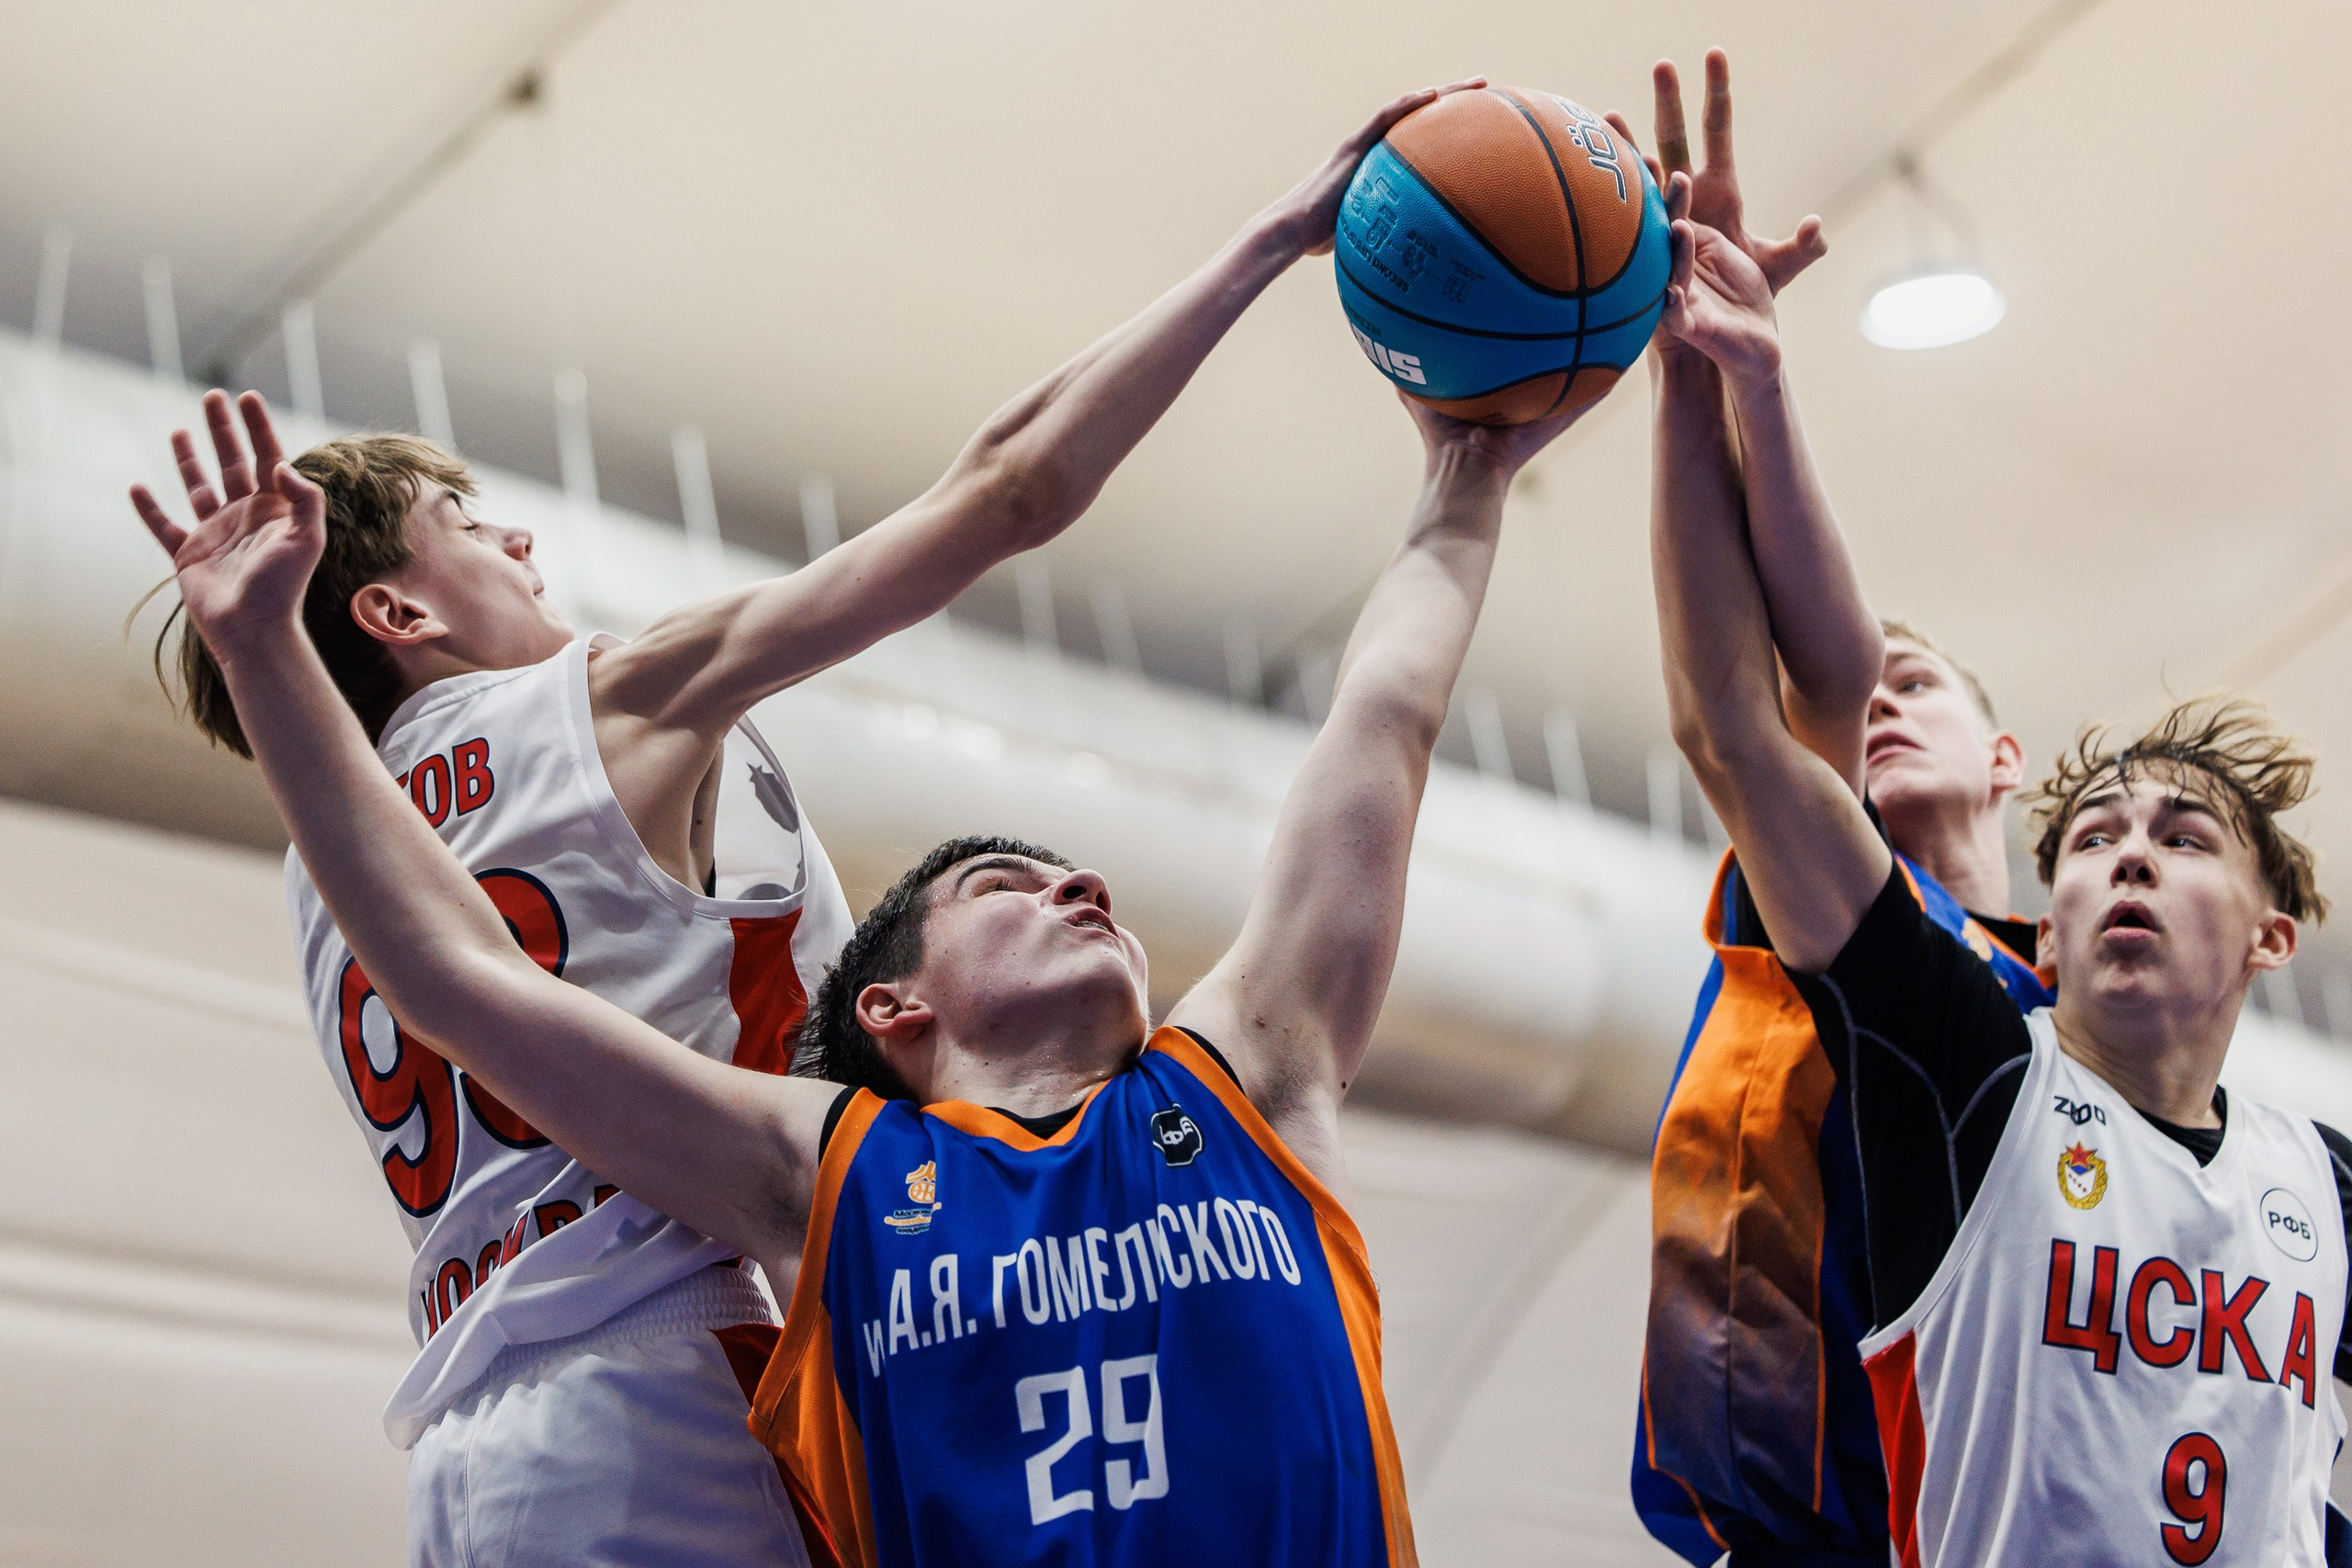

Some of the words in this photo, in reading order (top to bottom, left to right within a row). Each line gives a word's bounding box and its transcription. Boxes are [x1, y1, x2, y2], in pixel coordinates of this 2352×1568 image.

[395, 737, 495, 829] ОВ
[2268, 1211, 2311, 1240] РФБ
[889, 1253, 978, 1356] А.Я.
[2041, 1238, 2316, 1410] ЦСКА
[1014, 1353, 1170, 1526] 29
[2160, 1431, 2228, 1568] 9
